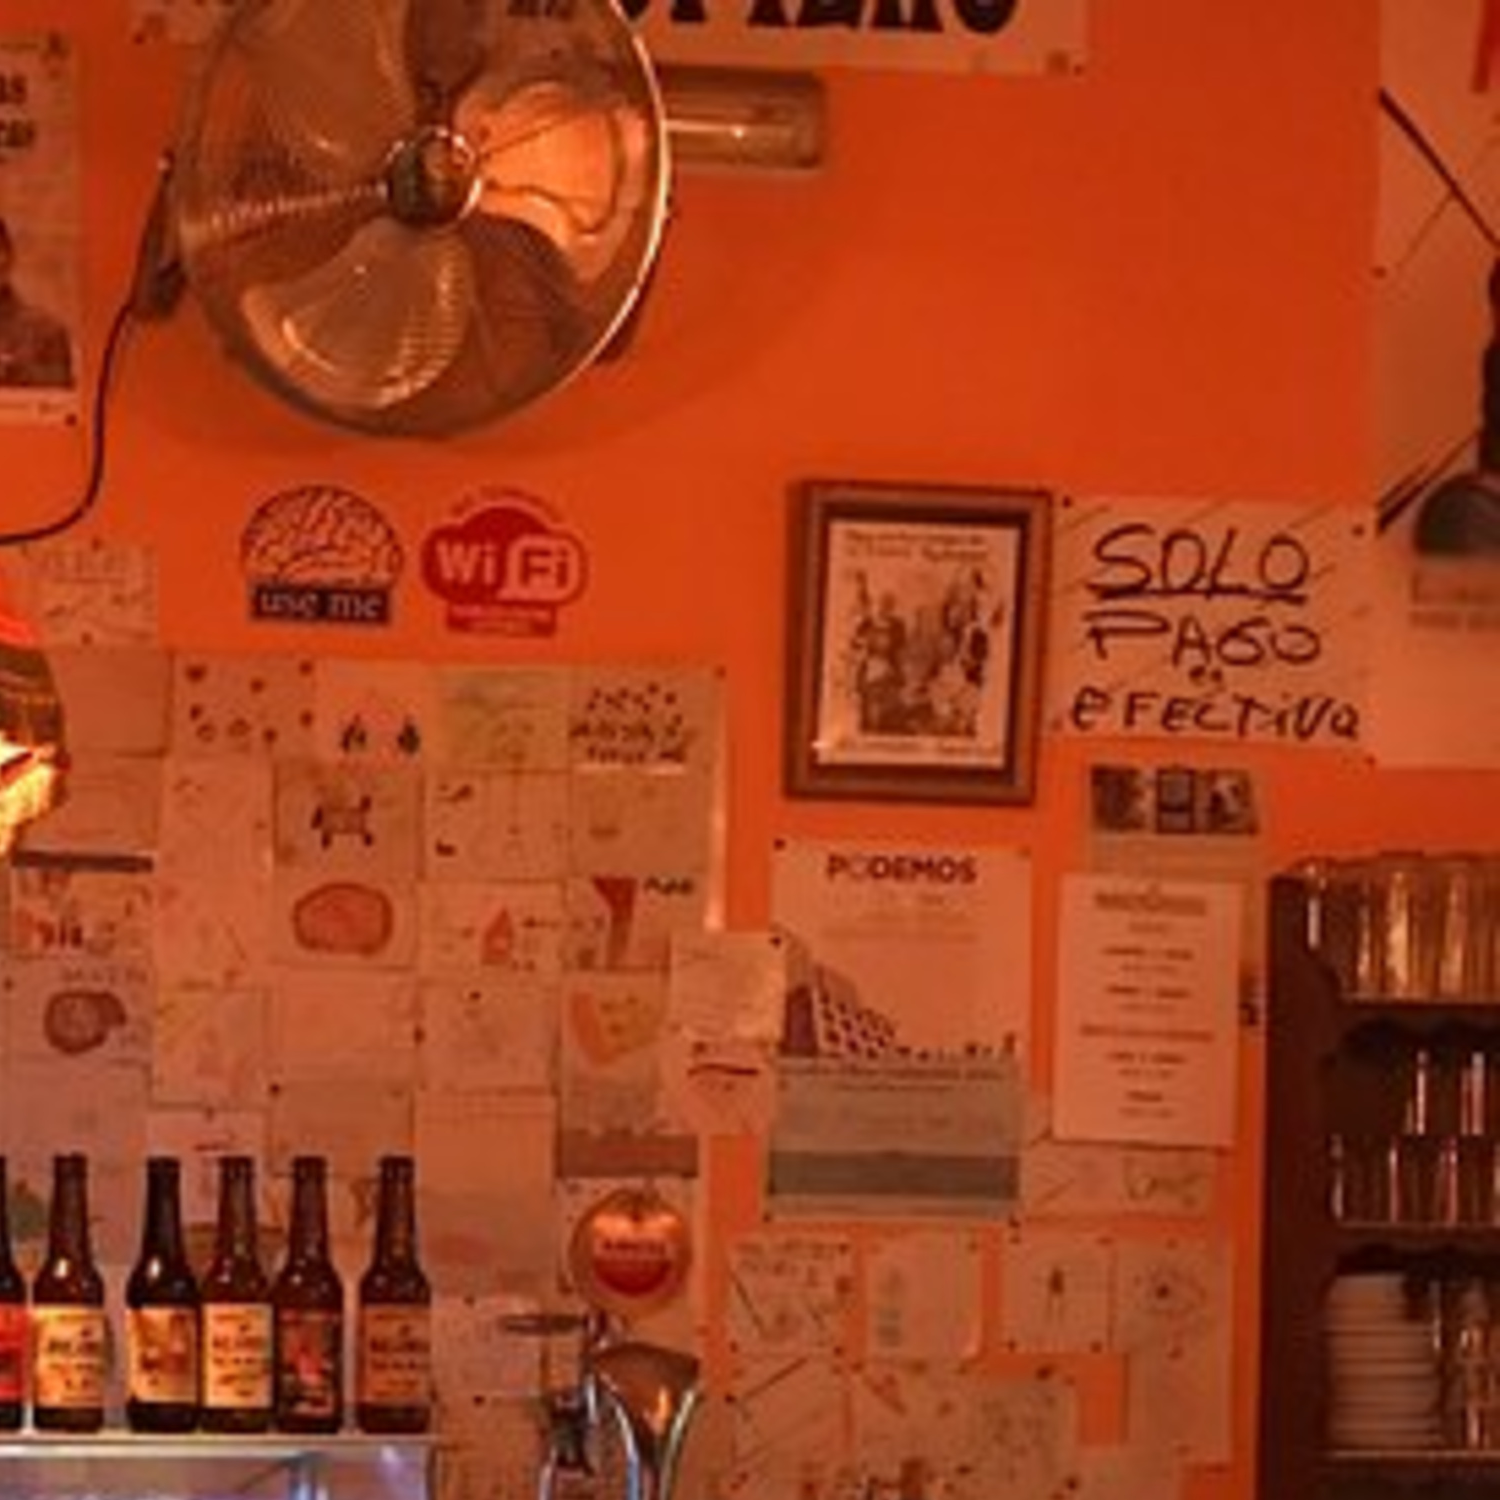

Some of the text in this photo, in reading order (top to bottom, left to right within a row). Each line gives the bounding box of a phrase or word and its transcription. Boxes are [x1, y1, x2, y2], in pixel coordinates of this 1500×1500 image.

[1086, 522, 1309, 603] SOLO
[1082, 609, 1321, 667] PAGO
[826, 854, 978, 884] PODEMOS
